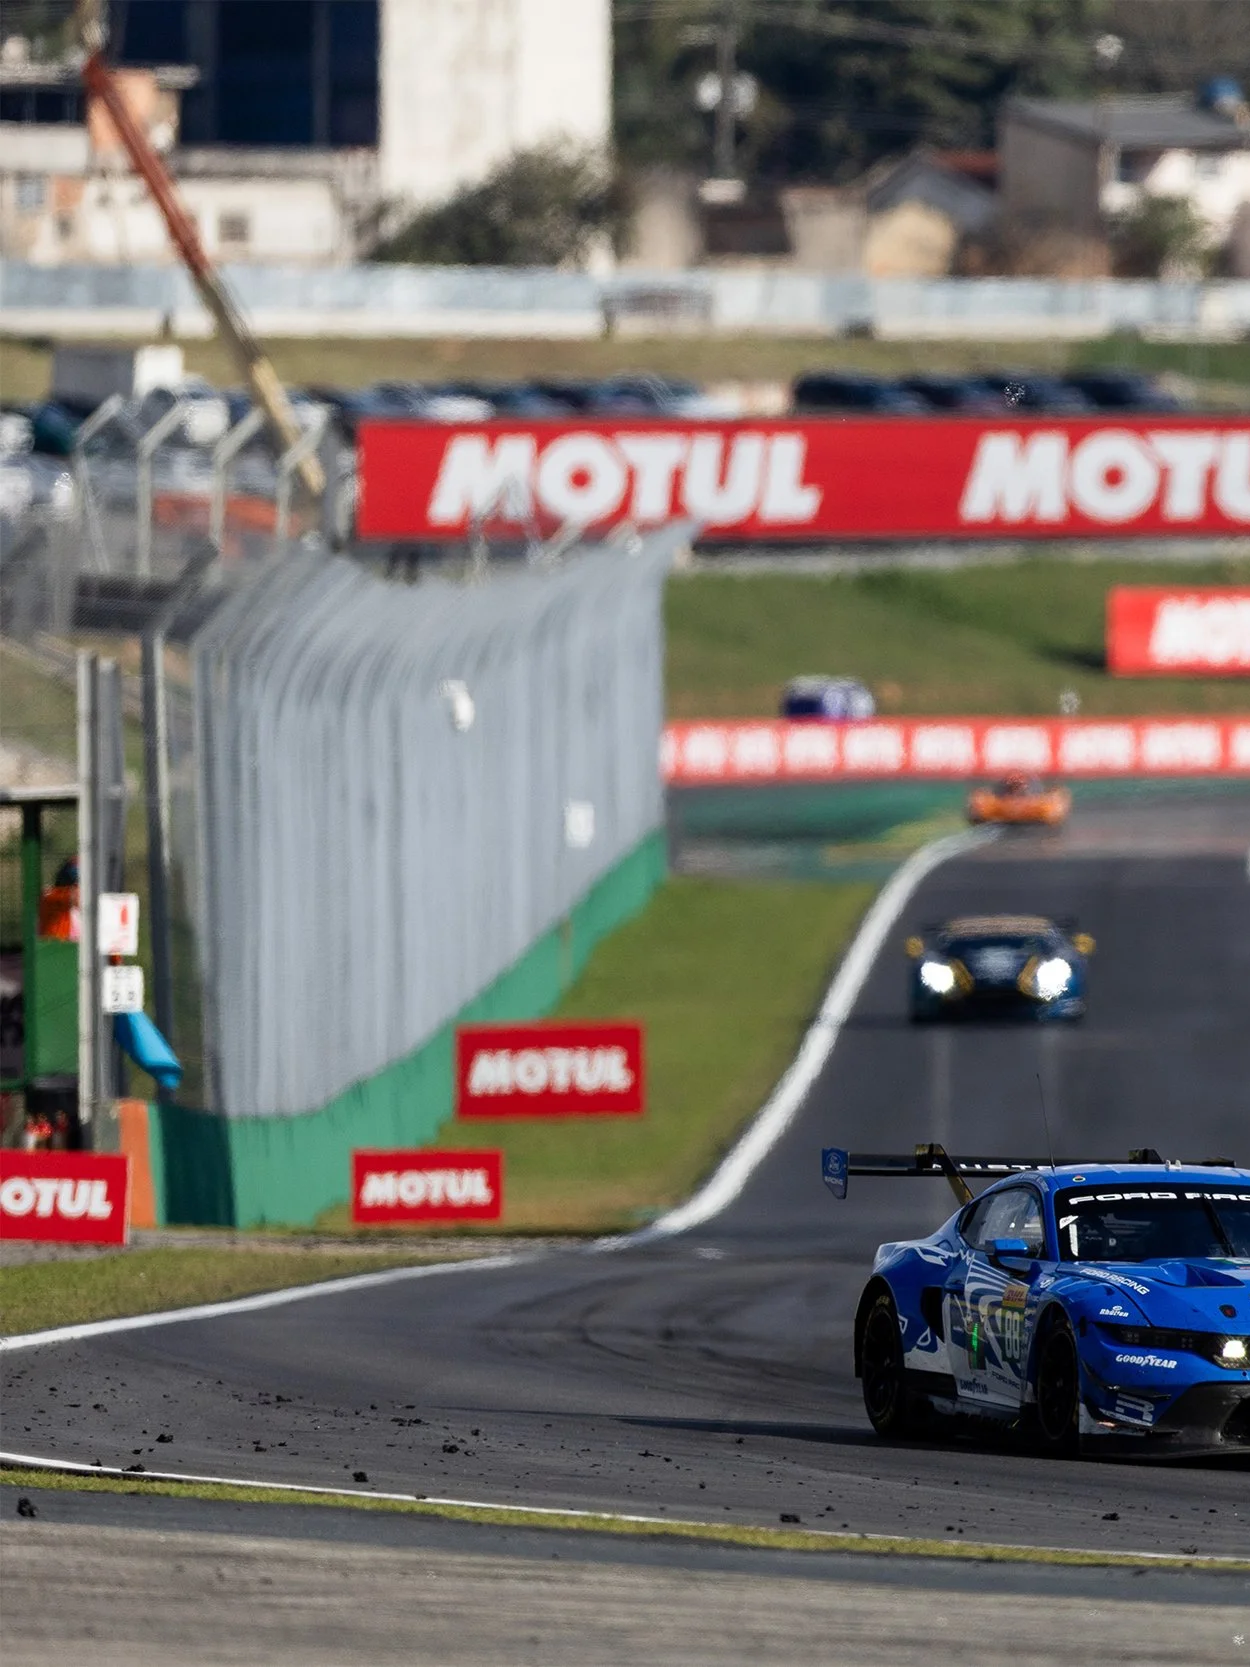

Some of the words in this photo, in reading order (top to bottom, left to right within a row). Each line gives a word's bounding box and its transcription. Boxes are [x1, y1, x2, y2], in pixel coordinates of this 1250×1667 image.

[427, 432, 823, 525] MOTUL
[468, 1046, 632, 1097] MOTUL
[361, 1168, 494, 1207] MOTUL
[1069, 1192, 1178, 1205] FORD
[1079, 1268, 1110, 1279] FORD
[1107, 1274, 1150, 1295] RACING
[1005, 1310, 1020, 1360] 88
[1115, 1354, 1177, 1369] GOODYEAR
